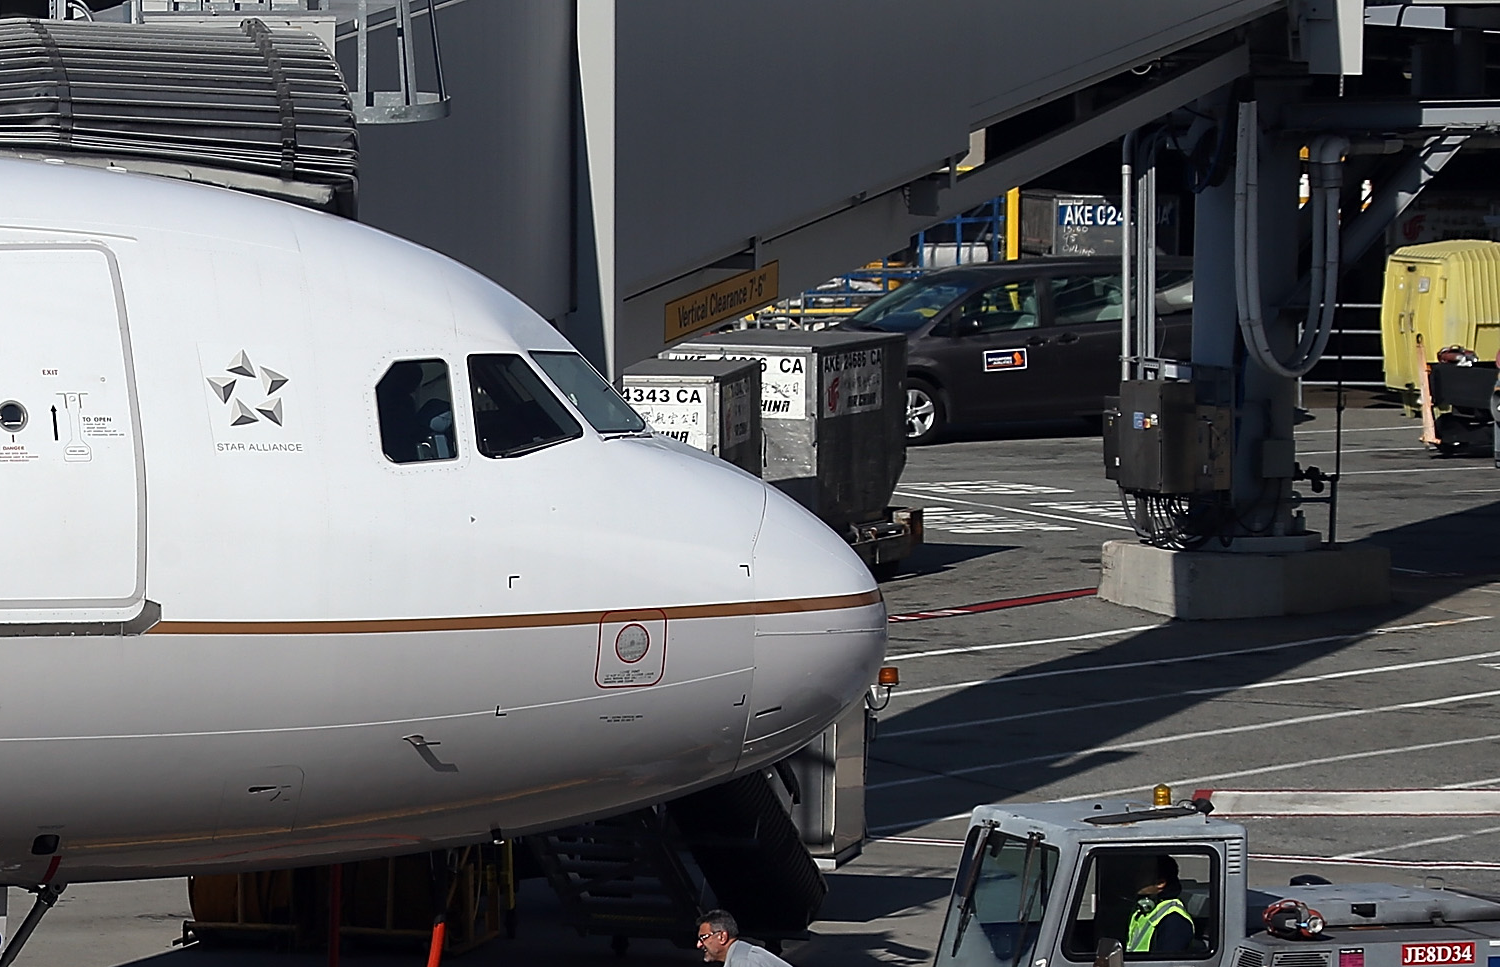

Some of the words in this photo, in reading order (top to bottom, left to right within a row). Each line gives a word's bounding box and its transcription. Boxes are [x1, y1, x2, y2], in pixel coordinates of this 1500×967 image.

[1065, 205, 1093, 225] AKE
[677, 296, 708, 329] Vertical
[709, 287, 748, 316] Clearance
[779, 358, 804, 374] CA
[621, 388, 671, 403] 4343
[675, 389, 702, 404] CA
[217, 443, 246, 452] STAR
[248, 443, 304, 452] ALLIANCE
[1404, 945, 1473, 964] JE8D34
